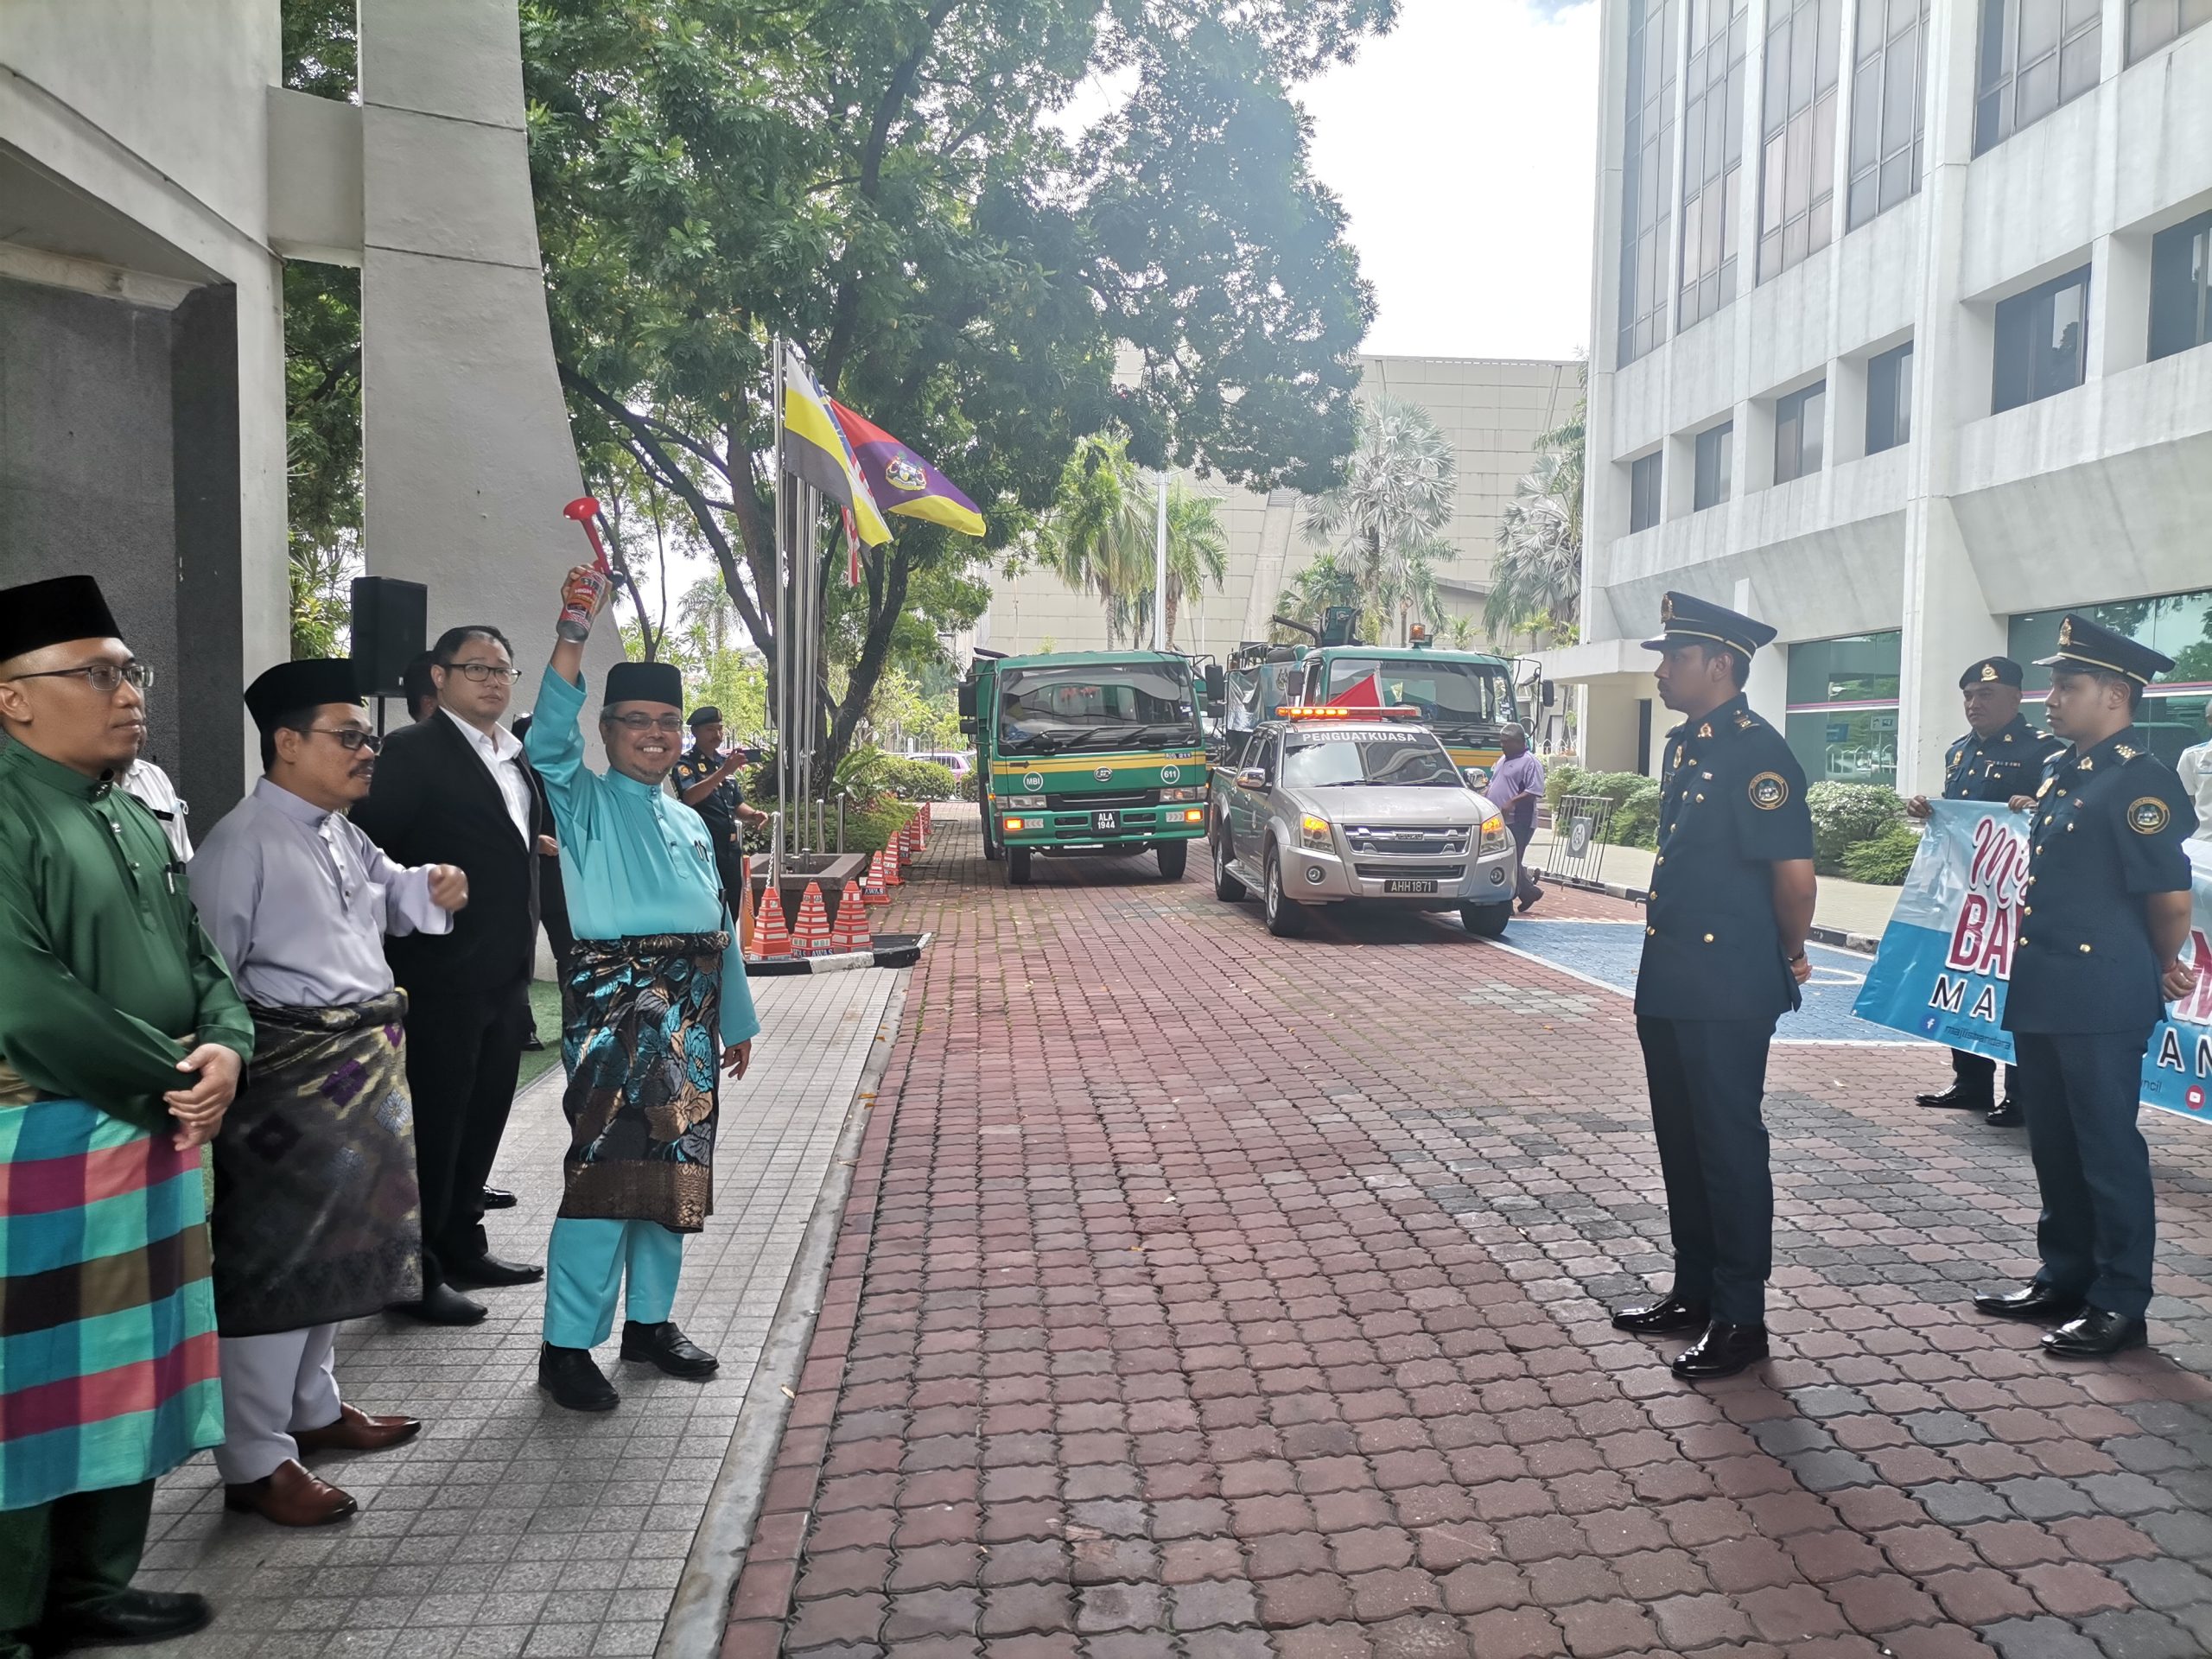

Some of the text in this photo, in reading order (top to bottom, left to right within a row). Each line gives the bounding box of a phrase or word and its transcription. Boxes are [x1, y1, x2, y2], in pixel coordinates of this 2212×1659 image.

[1302, 733, 1417, 742] PENGUATKUASA
[1164, 770, 1177, 779] 611
[1098, 812, 1114, 822] ALA
[1097, 821, 1116, 830] 1944
